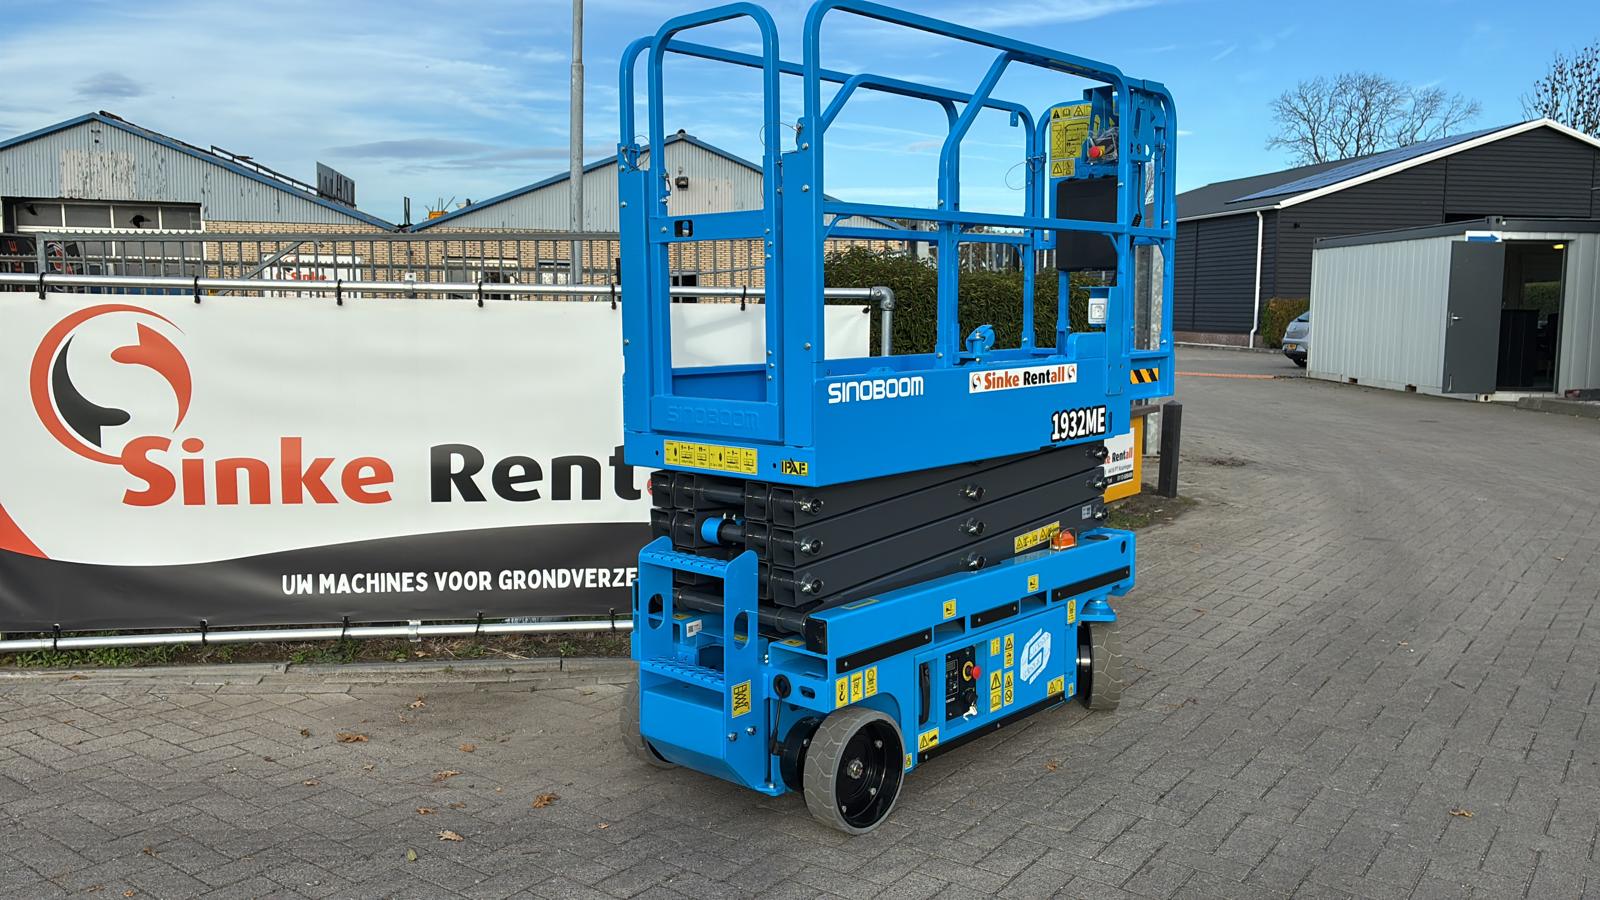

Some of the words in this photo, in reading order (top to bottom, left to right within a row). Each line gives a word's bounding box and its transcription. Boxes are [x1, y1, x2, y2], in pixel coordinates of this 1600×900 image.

[828, 376, 924, 404] SINOBOOM
[984, 371, 1019, 390] Sinke
[1023, 366, 1065, 386] Rentall
[1051, 406, 1106, 441] 1932ME
[121, 435, 394, 506] Sinke
[430, 443, 652, 503] Rent
[282, 574, 313, 595] UW
[318, 572, 428, 594] MACHINES
[434, 570, 492, 592] VOOR
[498, 567, 638, 590] GRONDVERZE
